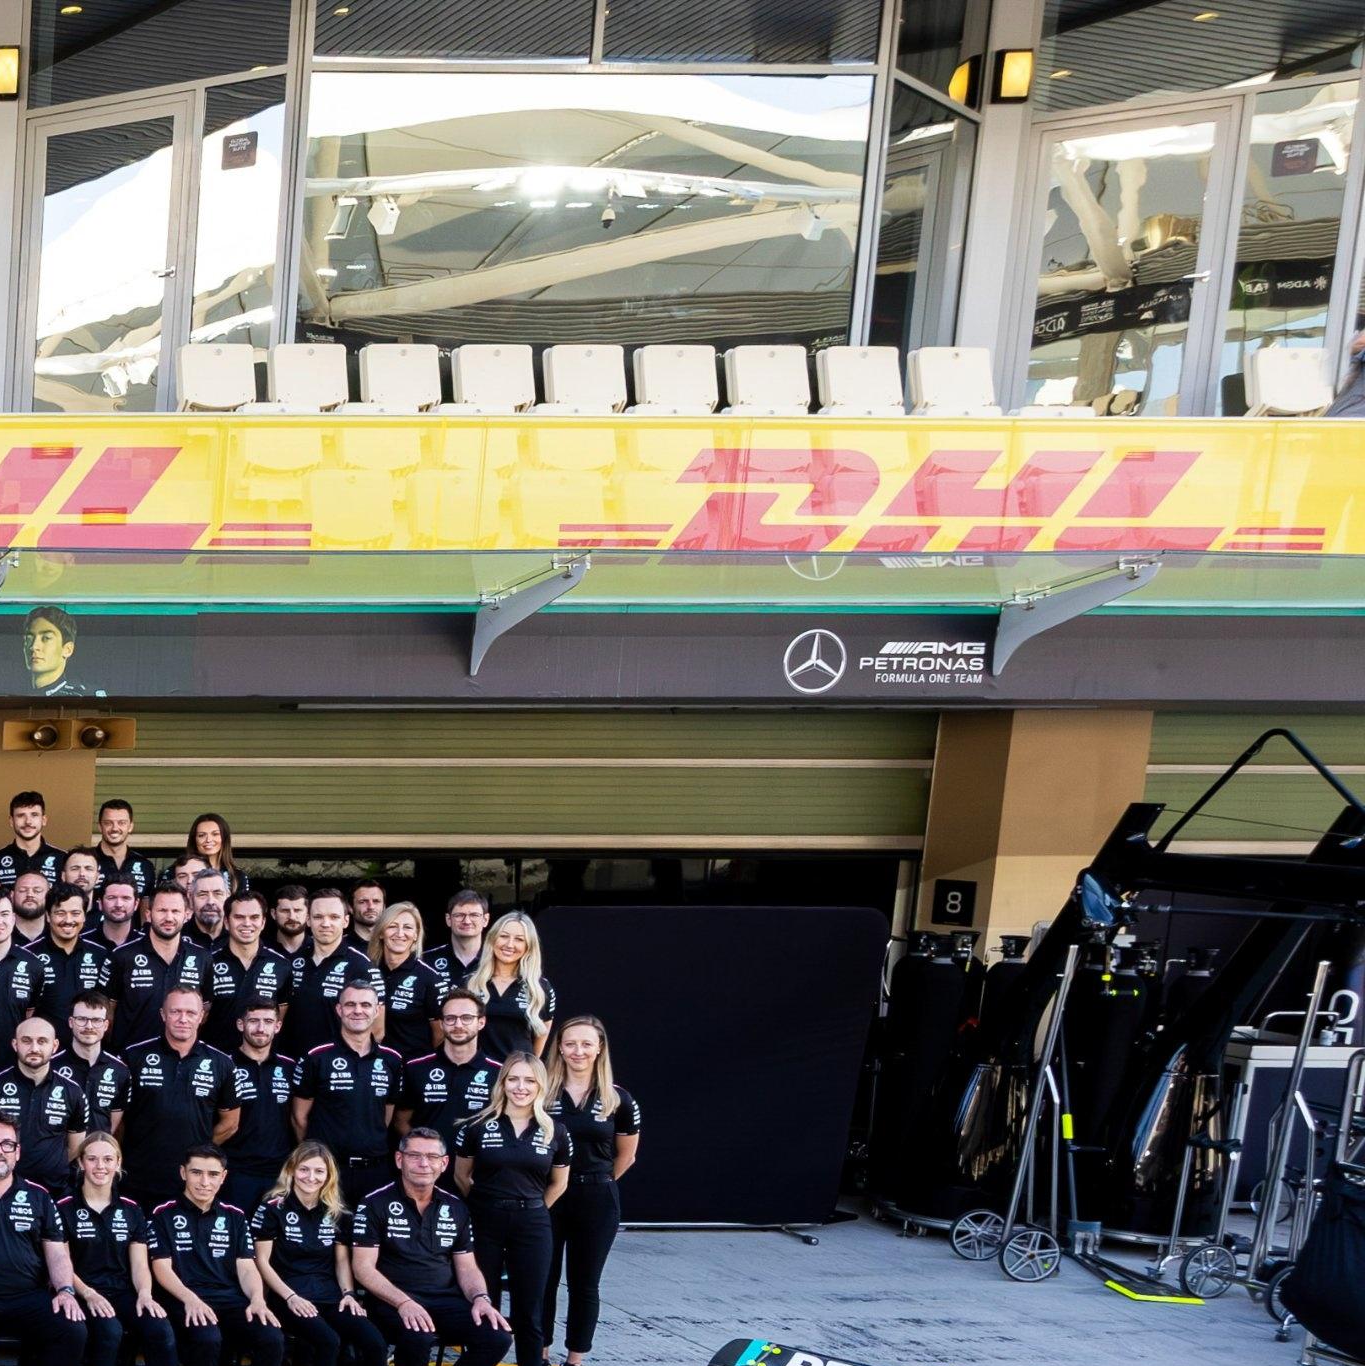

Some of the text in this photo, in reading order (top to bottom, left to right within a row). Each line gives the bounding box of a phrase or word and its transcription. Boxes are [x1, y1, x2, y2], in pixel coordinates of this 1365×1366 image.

[669, 449, 1231, 568] DHL
[914, 642, 986, 654] AMG
[859, 657, 984, 670] PETRONAS
[875, 673, 983, 684] FORMULA ONE TEAM
[946, 891, 961, 914] 8
